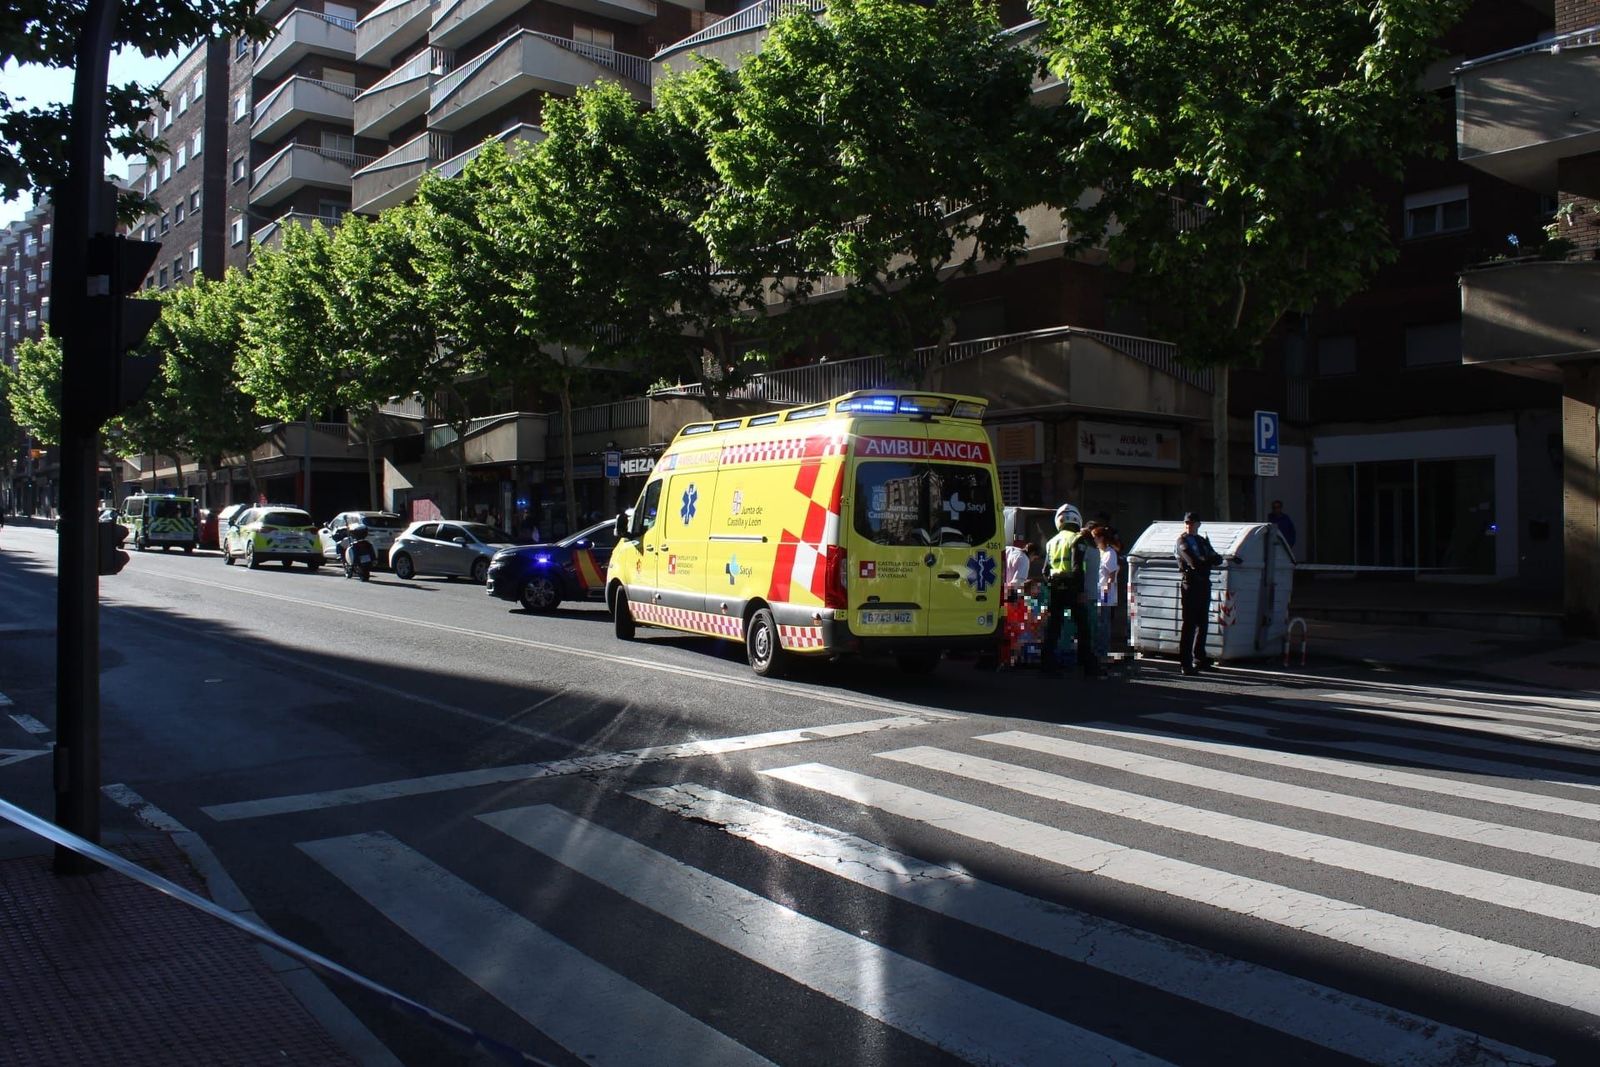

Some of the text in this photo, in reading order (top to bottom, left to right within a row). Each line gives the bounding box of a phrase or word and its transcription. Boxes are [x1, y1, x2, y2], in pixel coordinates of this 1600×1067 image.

[1261, 416, 1274, 449] P
[865, 439, 983, 460] AMBULANCIA
[887, 503, 908, 512] Junta
[967, 503, 986, 512] Sacyl
[986, 542, 1001, 550] 4361
